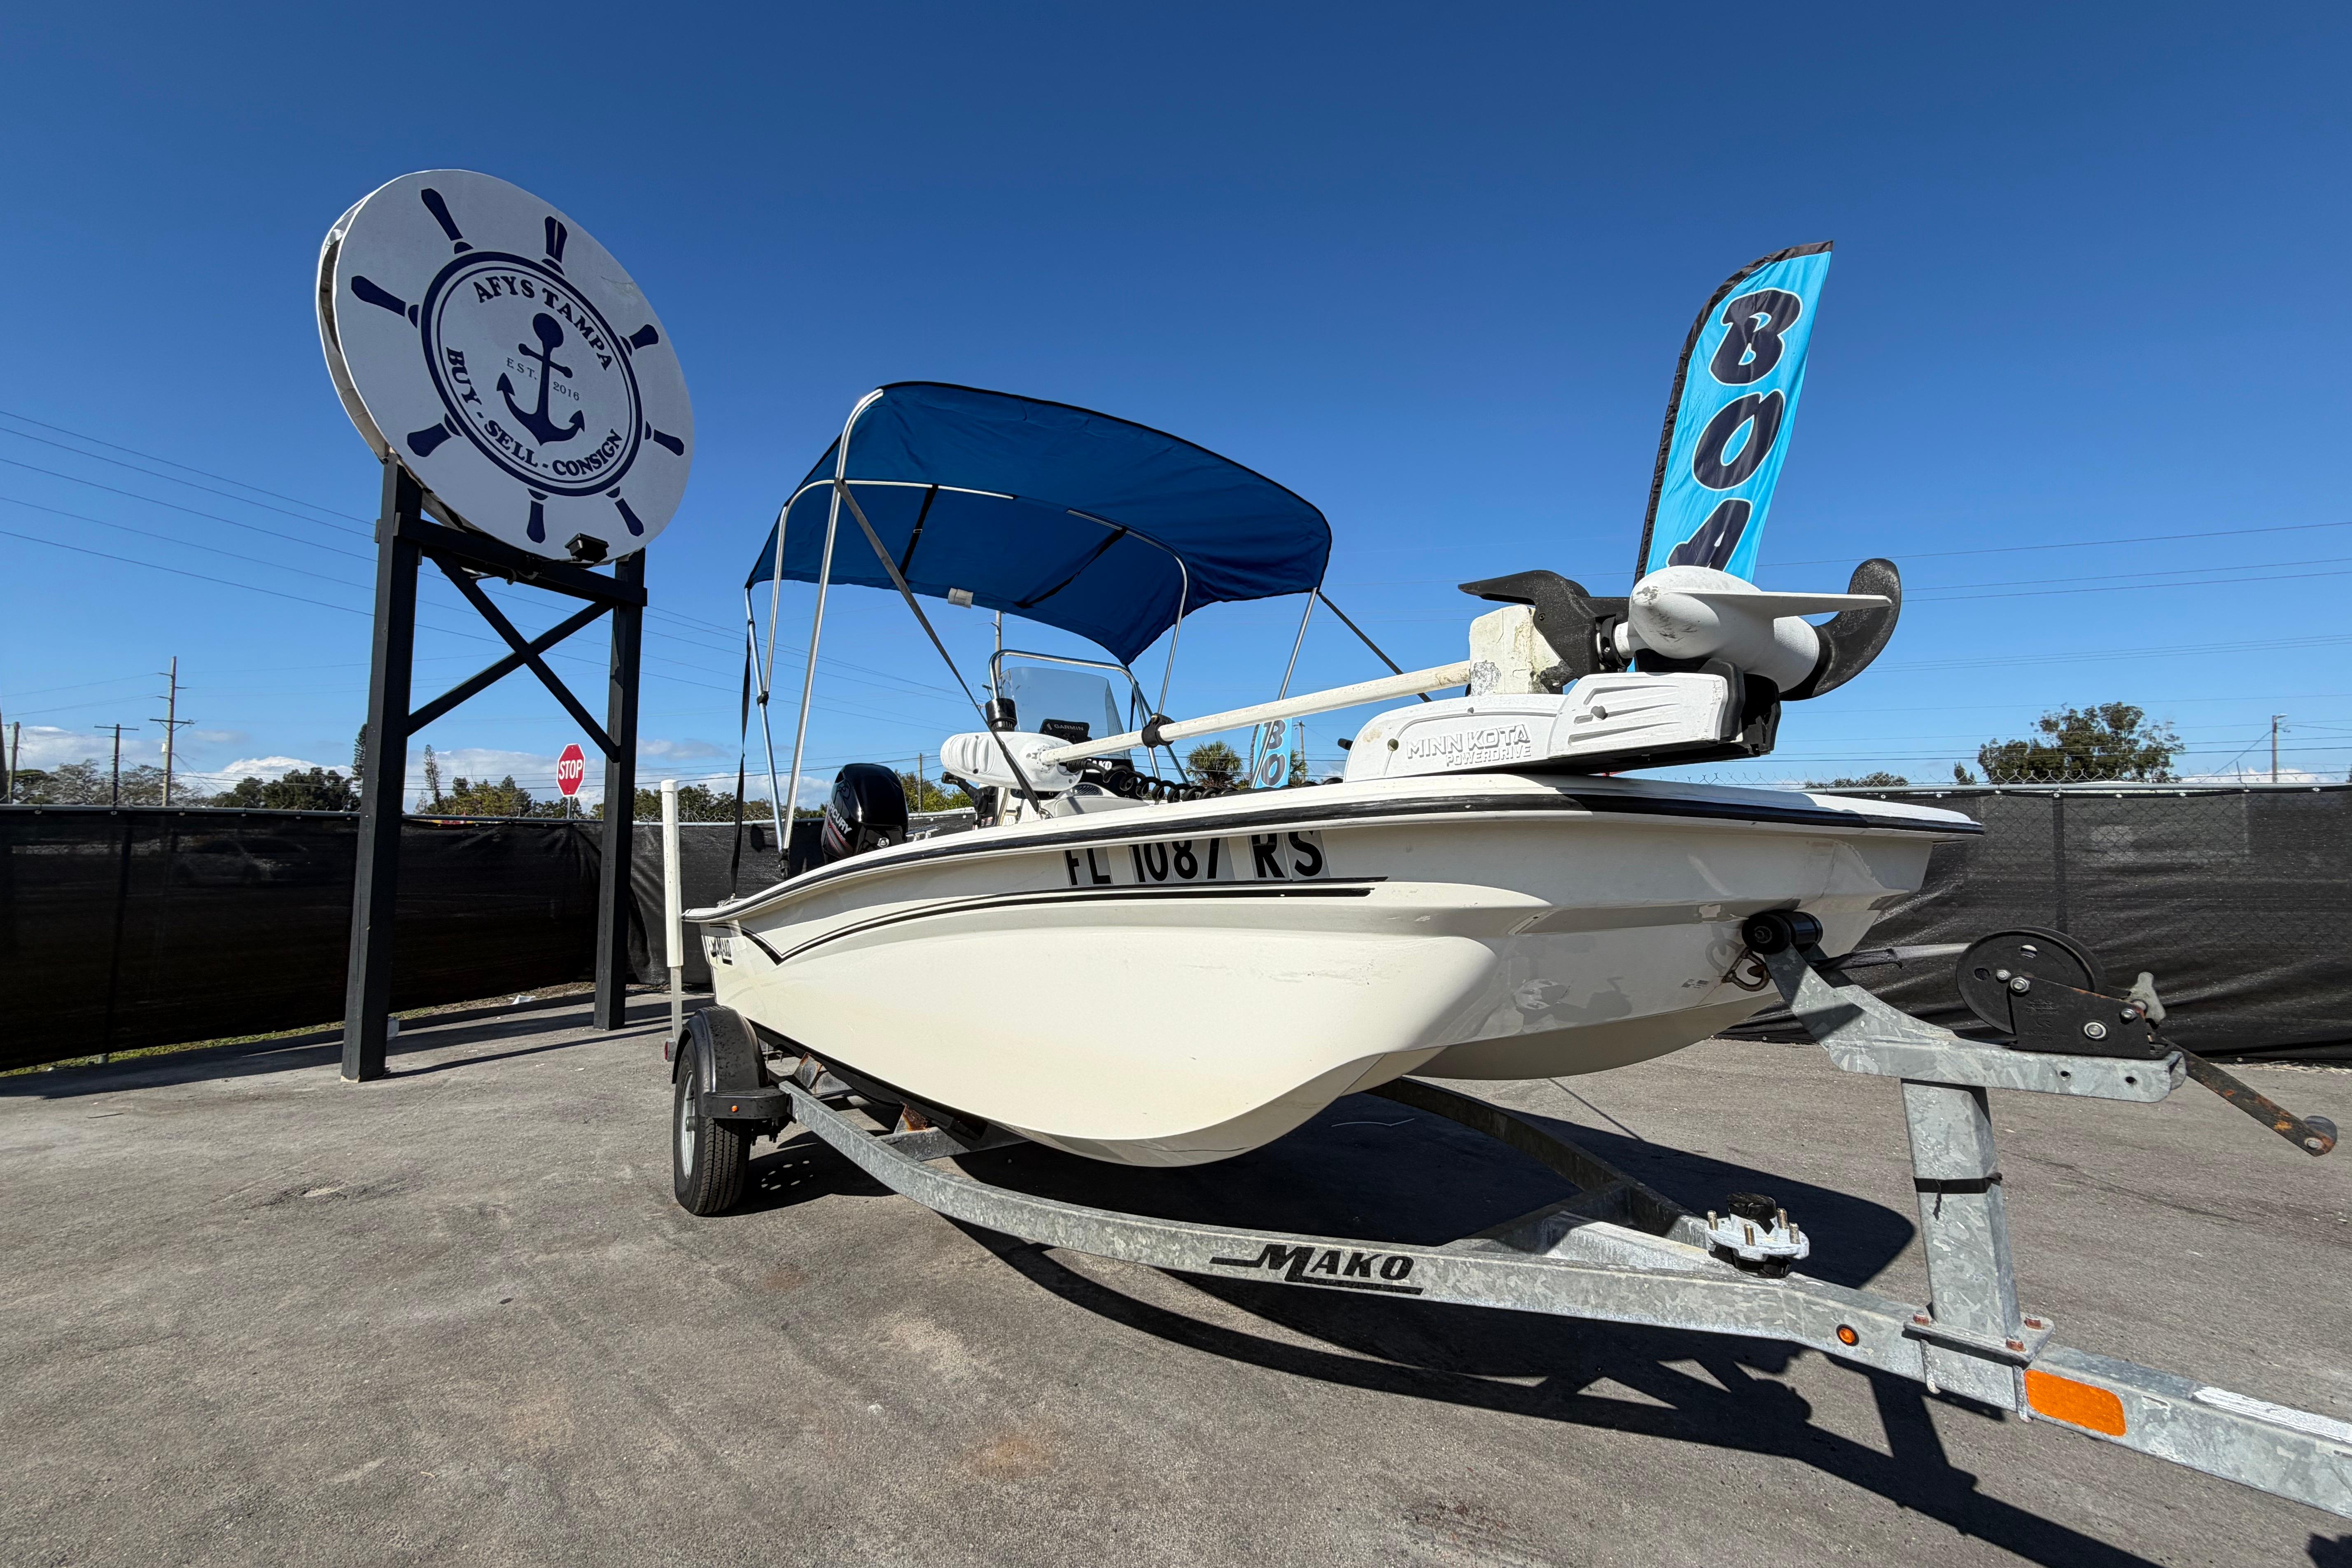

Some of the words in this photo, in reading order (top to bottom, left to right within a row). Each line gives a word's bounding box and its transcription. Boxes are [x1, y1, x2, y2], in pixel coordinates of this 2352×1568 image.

[474, 276, 534, 303] AFYS
[542, 287, 612, 371] TAMPA
[507, 357, 537, 380] EST.
[553, 381, 579, 401] 2016
[446, 347, 482, 405] BUY
[484, 420, 538, 467] SELL
[552, 429, 622, 476] CONSIGN
[1407, 734, 1463, 759] MINN
[1468, 724, 1531, 751] KOTA
[1445, 744, 1531, 767] POWERDRIVE
[559, 759, 583, 779] STOP
[1065, 847, 1112, 885] FL
[1251, 830, 1323, 878] RS
[1209, 1244, 1424, 1295] MAKO
